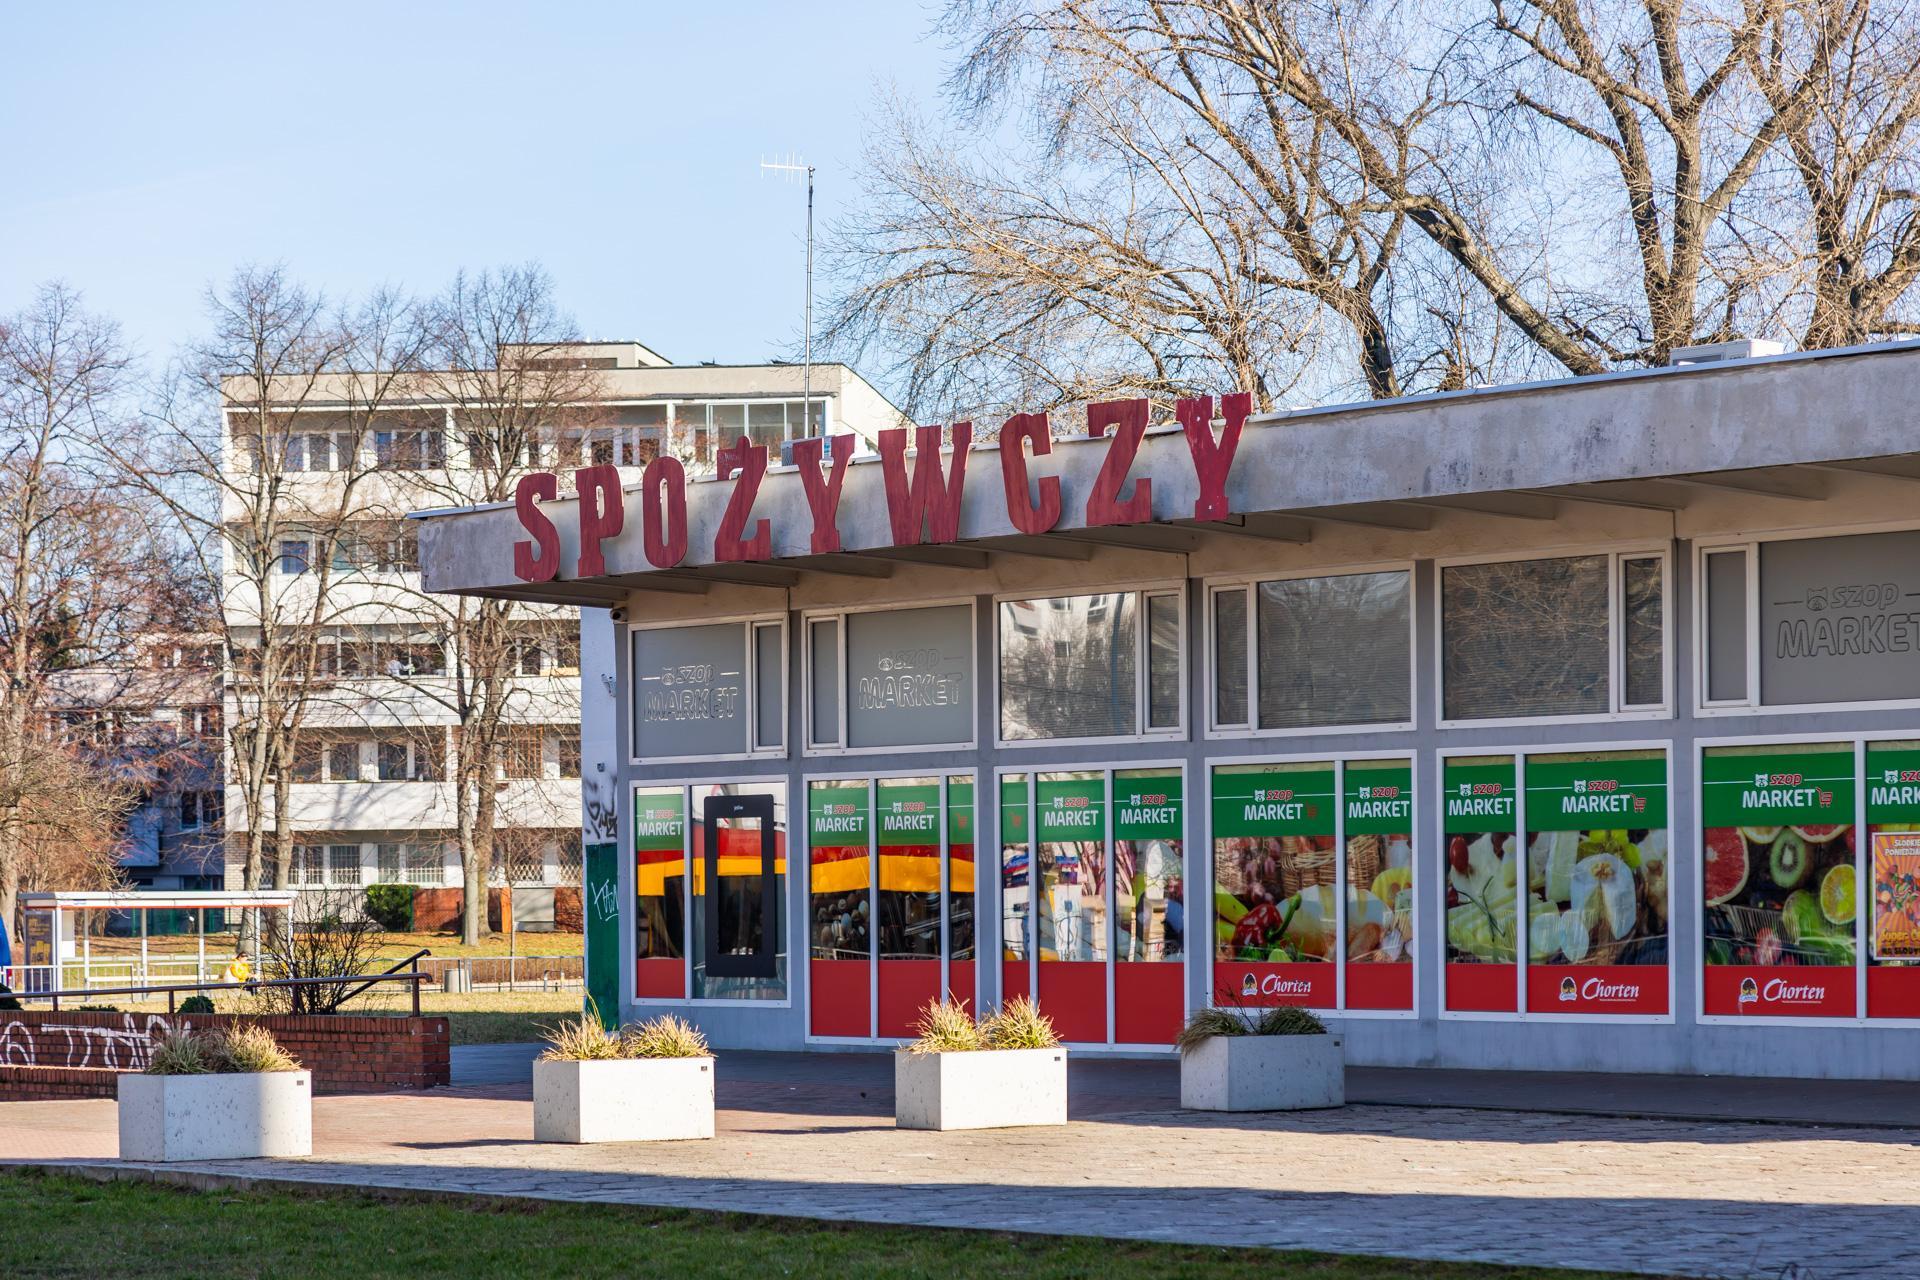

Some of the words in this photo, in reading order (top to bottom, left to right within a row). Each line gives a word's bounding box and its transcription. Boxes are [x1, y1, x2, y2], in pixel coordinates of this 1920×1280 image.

[515, 392, 1254, 582] SPOŻYWCZY
[858, 671, 964, 710] MARKET
[643, 687, 739, 722] MARKET
[1448, 797, 1514, 816] MARKET
[1562, 794, 1631, 814] MARKET
[1742, 788, 1816, 809] MARKET
[1044, 810, 1099, 827] MARKET
[1120, 807, 1177, 825] MARKET
[1244, 803, 1304, 821] MARKET
[1348, 800, 1410, 819] MARKET
[638, 821, 683, 836] MARKET
[815, 816, 864, 832] MARKET
[884, 814, 935, 831] MARKET
[1261, 974, 1311, 995] Chorten
[1581, 977, 1640, 1000] Chorten
[1763, 978, 1825, 1002] Chorten
